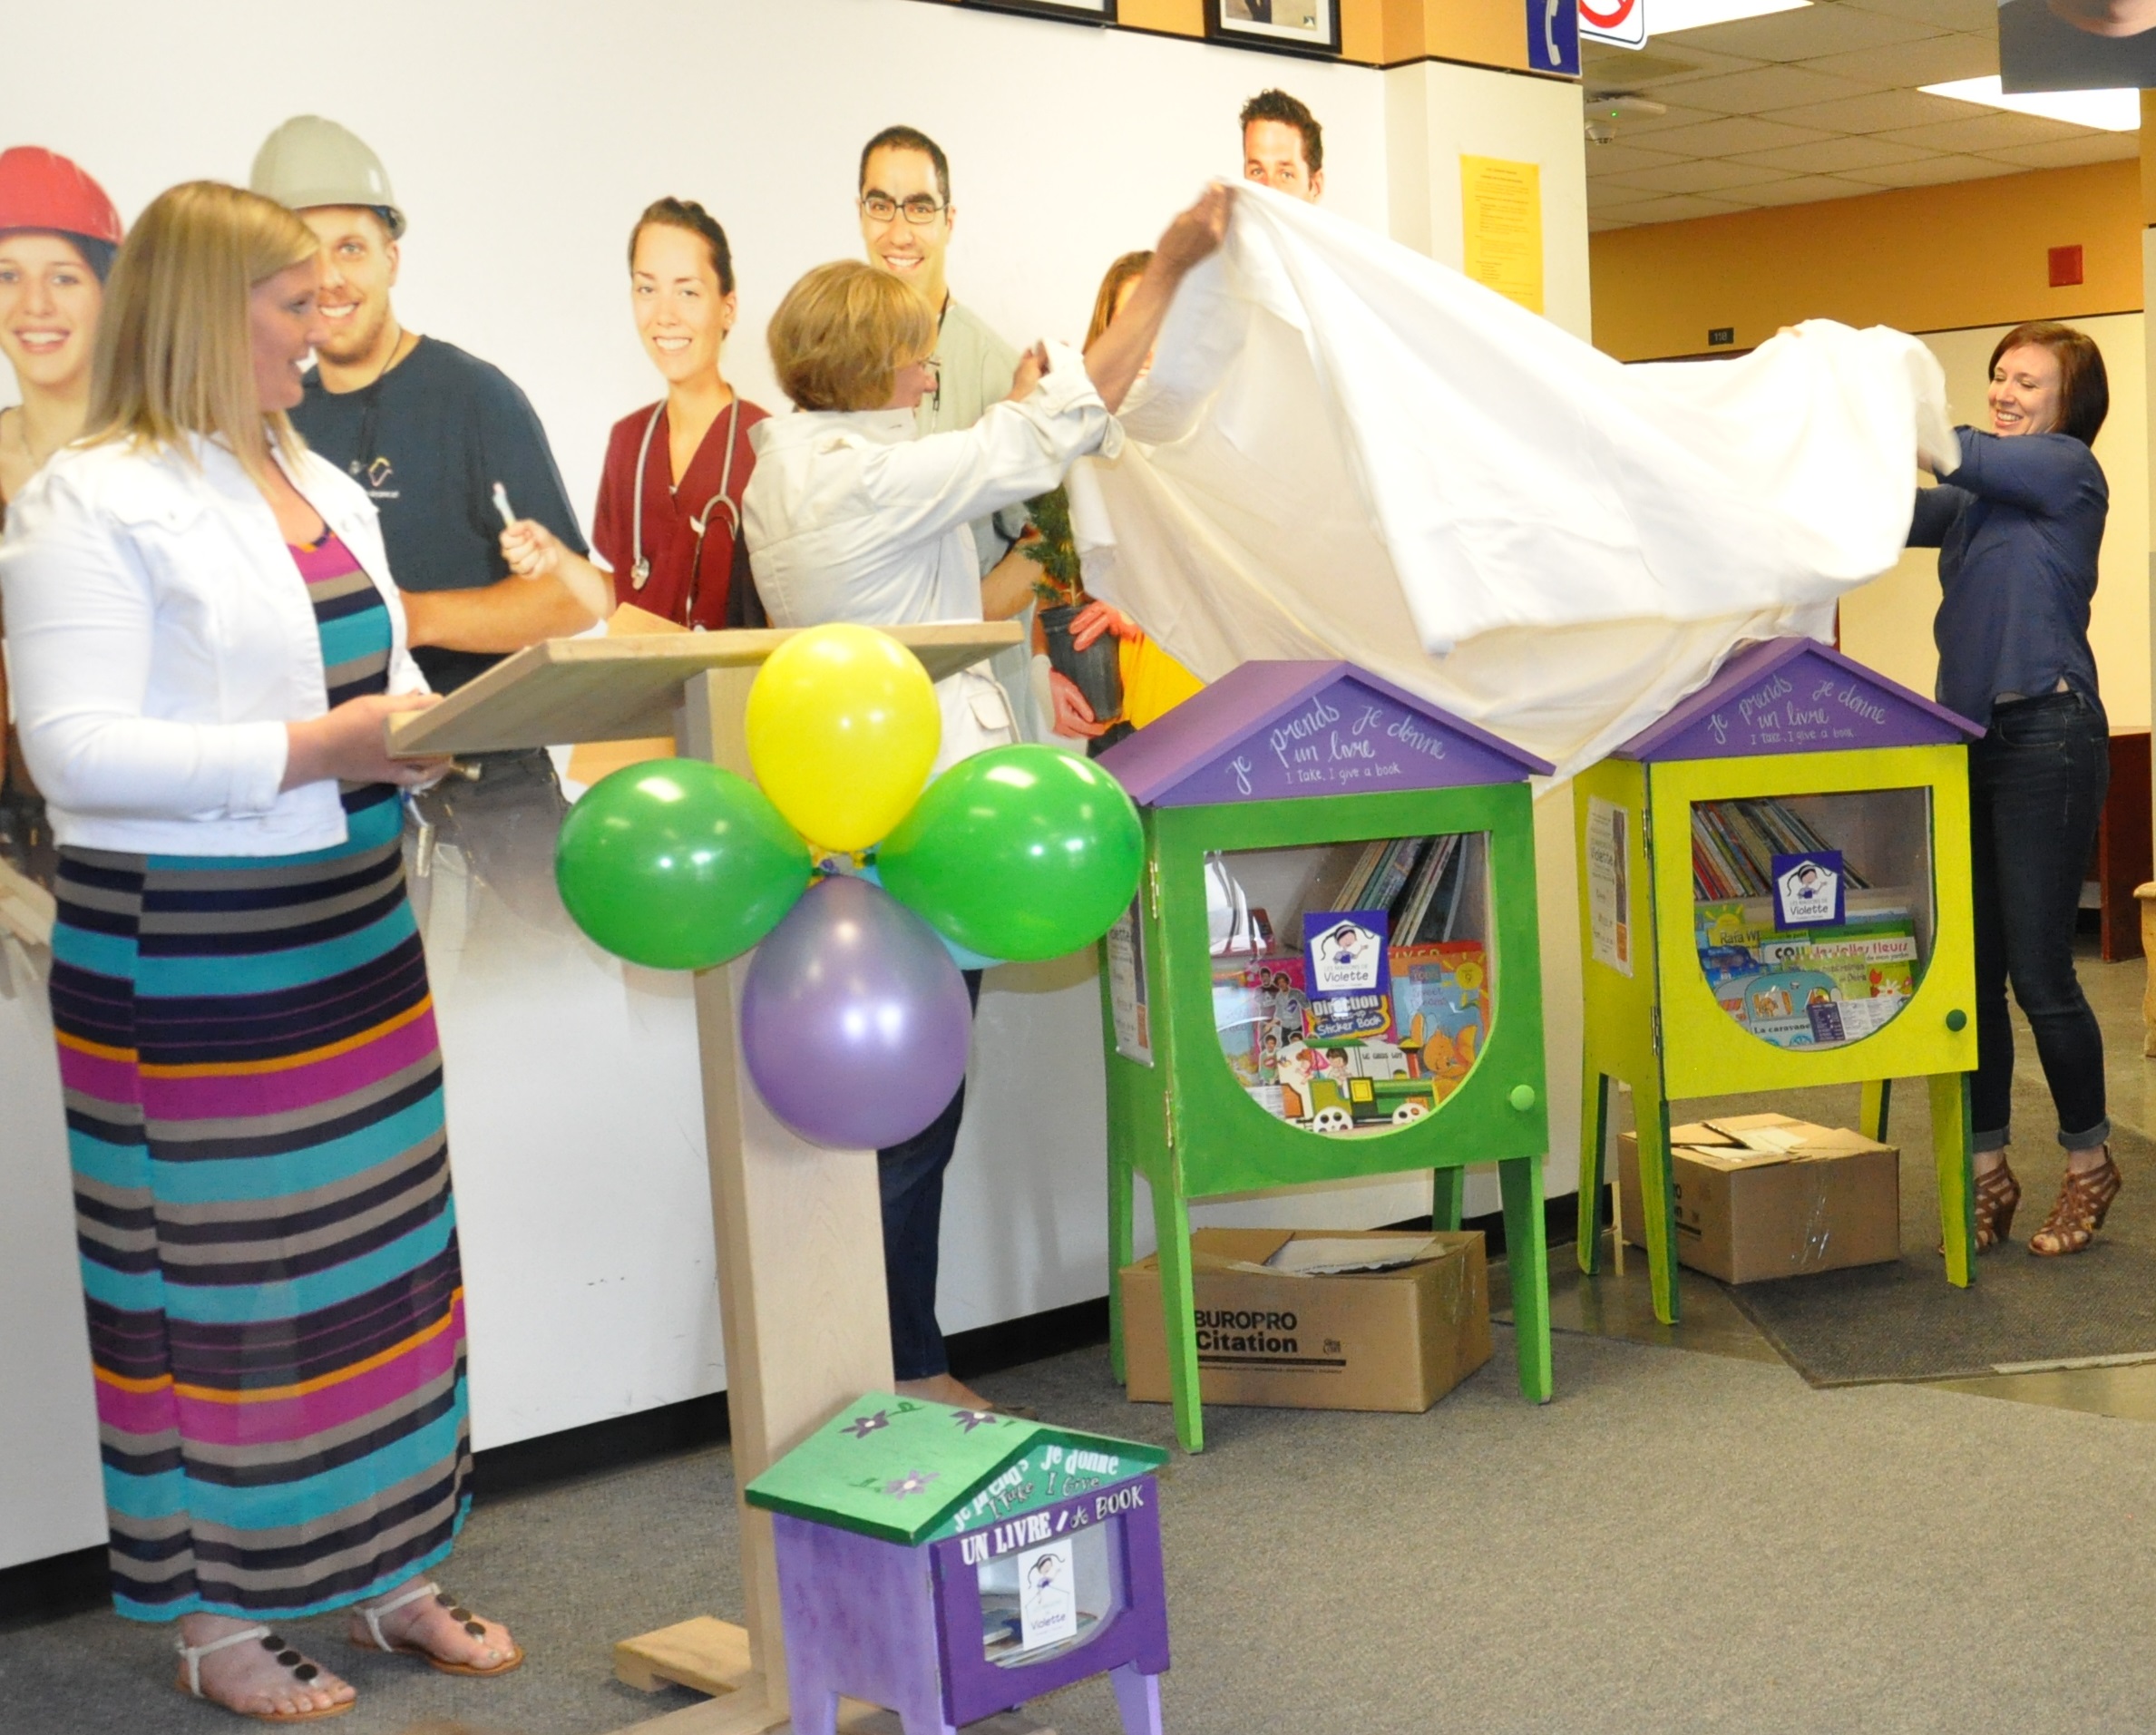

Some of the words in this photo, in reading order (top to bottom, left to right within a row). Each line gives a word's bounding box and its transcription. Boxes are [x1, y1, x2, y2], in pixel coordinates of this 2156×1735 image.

[1739, 674, 1793, 726] prends
[1839, 685, 1887, 725] donne
[1757, 710, 1780, 729] un
[1787, 700, 1829, 726] livre
[1270, 697, 1341, 768] prends
[1387, 716, 1446, 760] donne
[1294, 746, 1319, 765] un
[1328, 730, 1376, 763] livre
[1341, 768, 1360, 785] give
[1364, 769, 1371, 777] a
[1790, 904, 1829, 915] Violette
[1873, 941, 1907, 953] fleurs
[1324, 970, 1369, 982] Violette
[1317, 1021, 1353, 1036] Sticker
[1356, 1015, 1381, 1028] Book
[1754, 1026, 1765, 1034] La
[1195, 1310, 1297, 1330] BUROPRO
[1196, 1330, 1298, 1353] Citation
[1065, 1448, 1119, 1476] donne
[961, 1533, 990, 1565] UN
[994, 1511, 1052, 1554] LIVRE
[1096, 1485, 1144, 1520] BOOK
